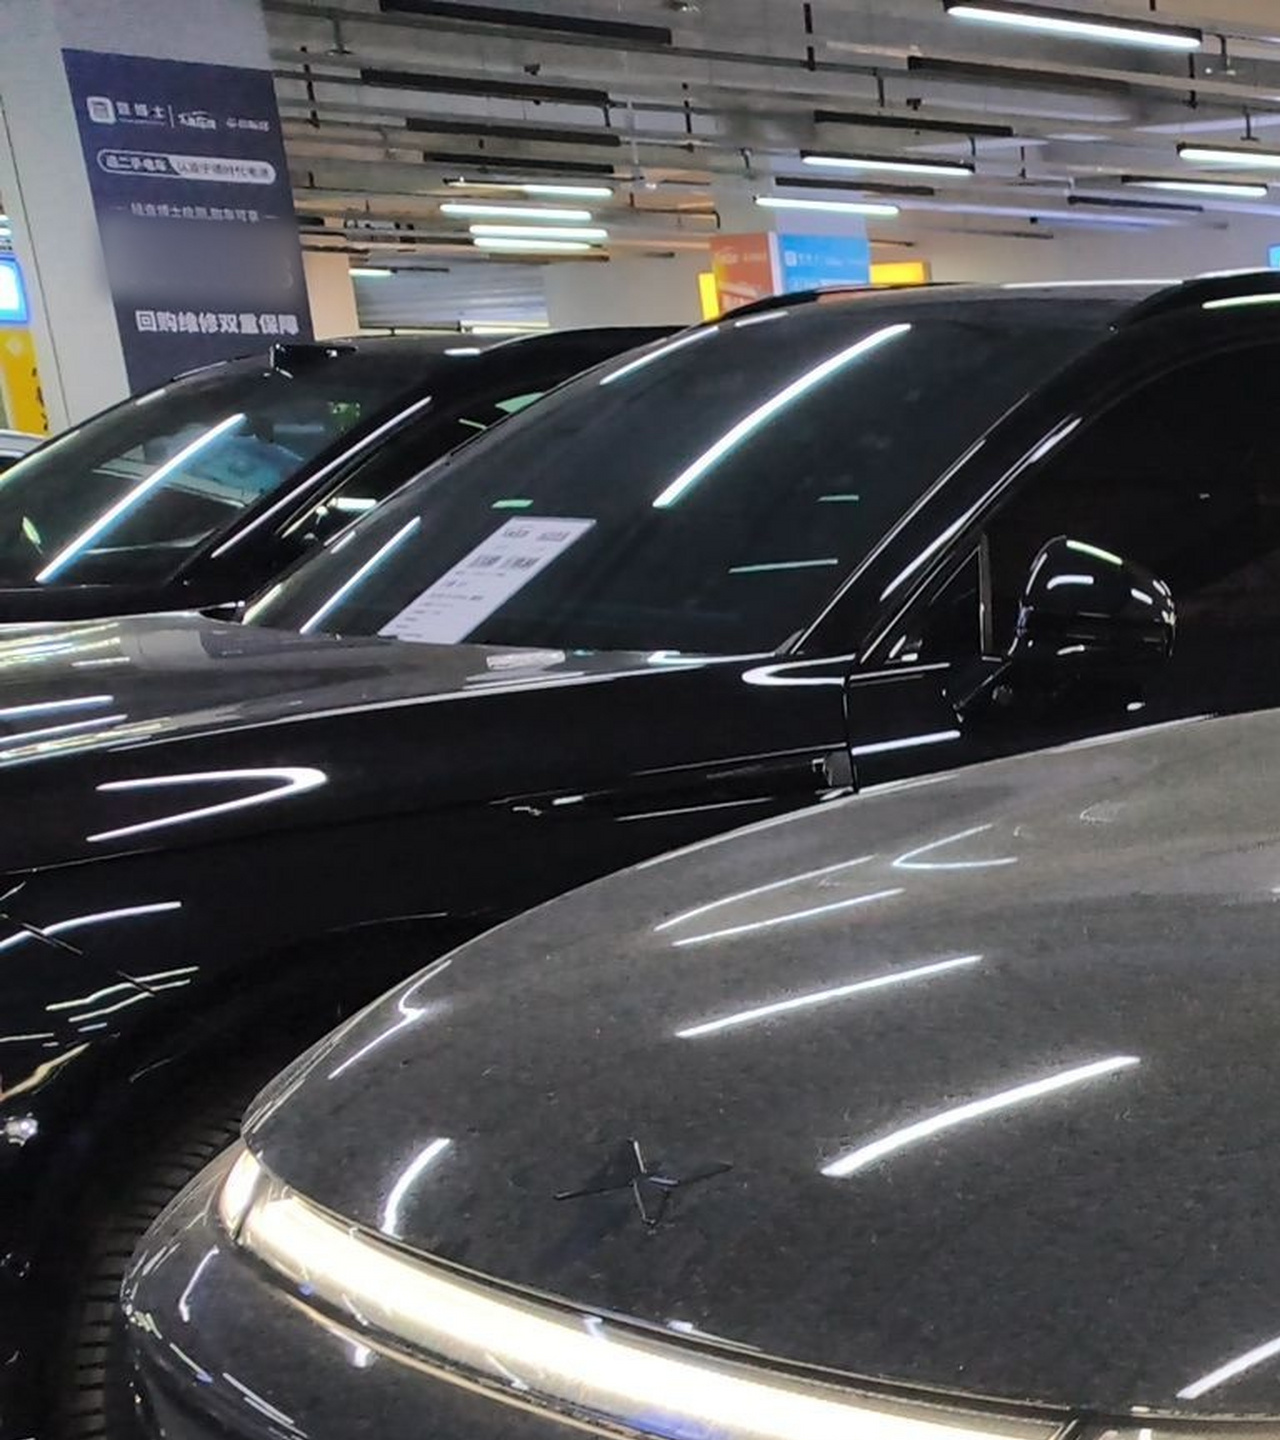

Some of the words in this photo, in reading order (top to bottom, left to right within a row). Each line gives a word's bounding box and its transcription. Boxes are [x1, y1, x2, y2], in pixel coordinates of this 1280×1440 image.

[135, 310, 299, 335] 回购维修双重保障
